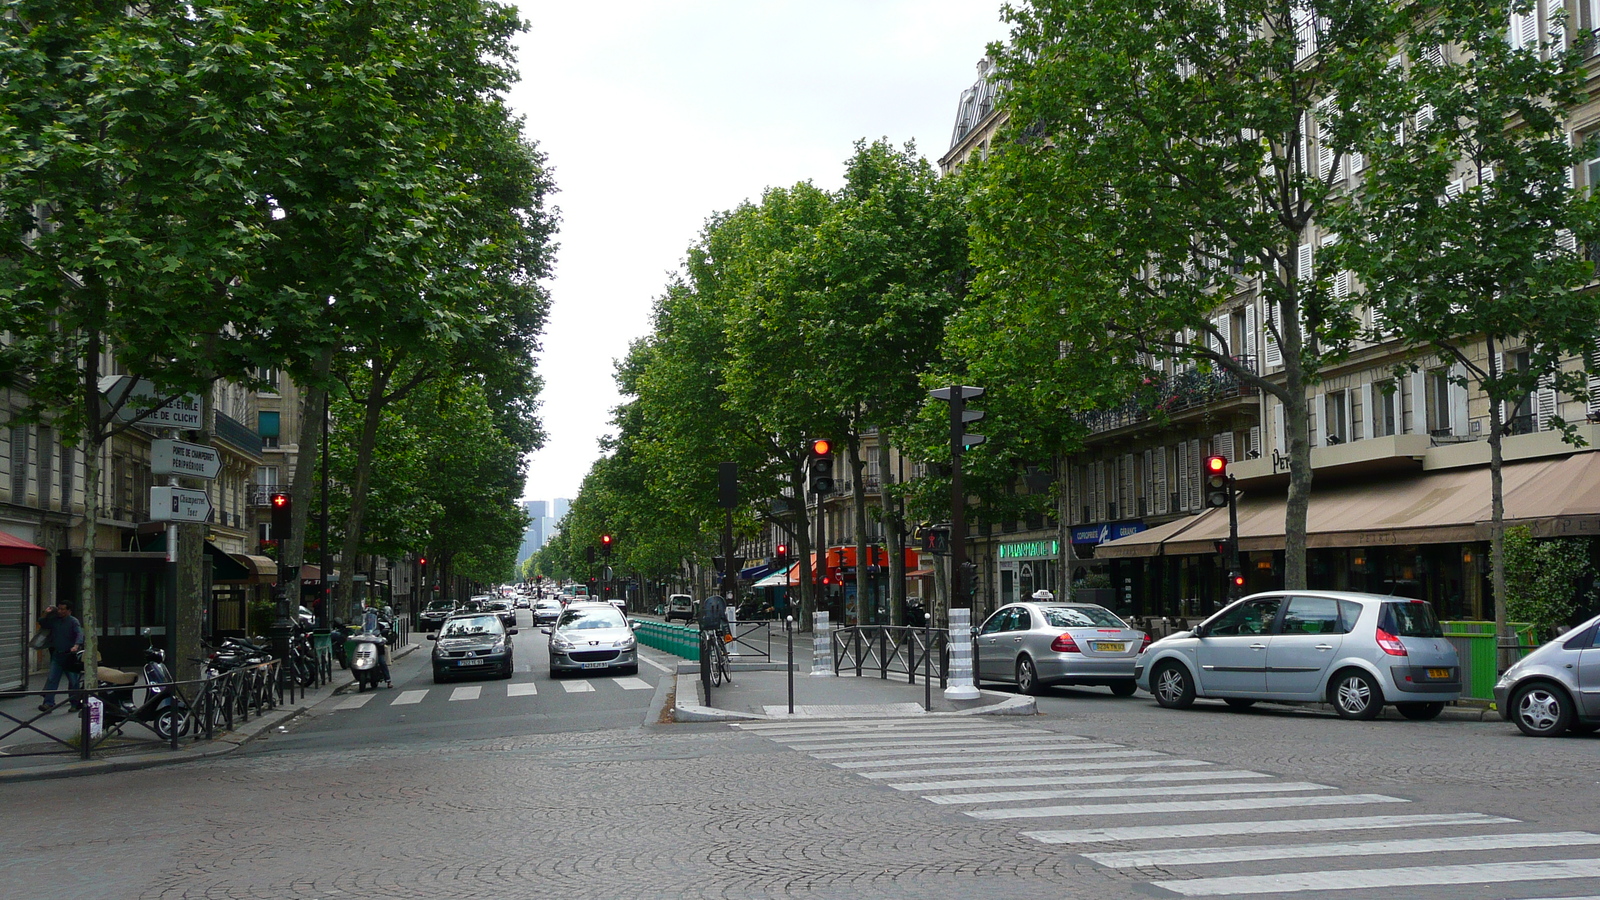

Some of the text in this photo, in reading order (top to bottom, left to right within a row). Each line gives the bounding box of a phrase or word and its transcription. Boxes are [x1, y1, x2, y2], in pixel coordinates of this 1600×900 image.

[160, 410, 170, 420] DE
[173, 412, 198, 423] CLICHY
[173, 446, 215, 462] PORTE DE CHAMPERRET
[1272, 448, 1290, 474] PET
[1007, 541, 1049, 558] PHARMACIE
